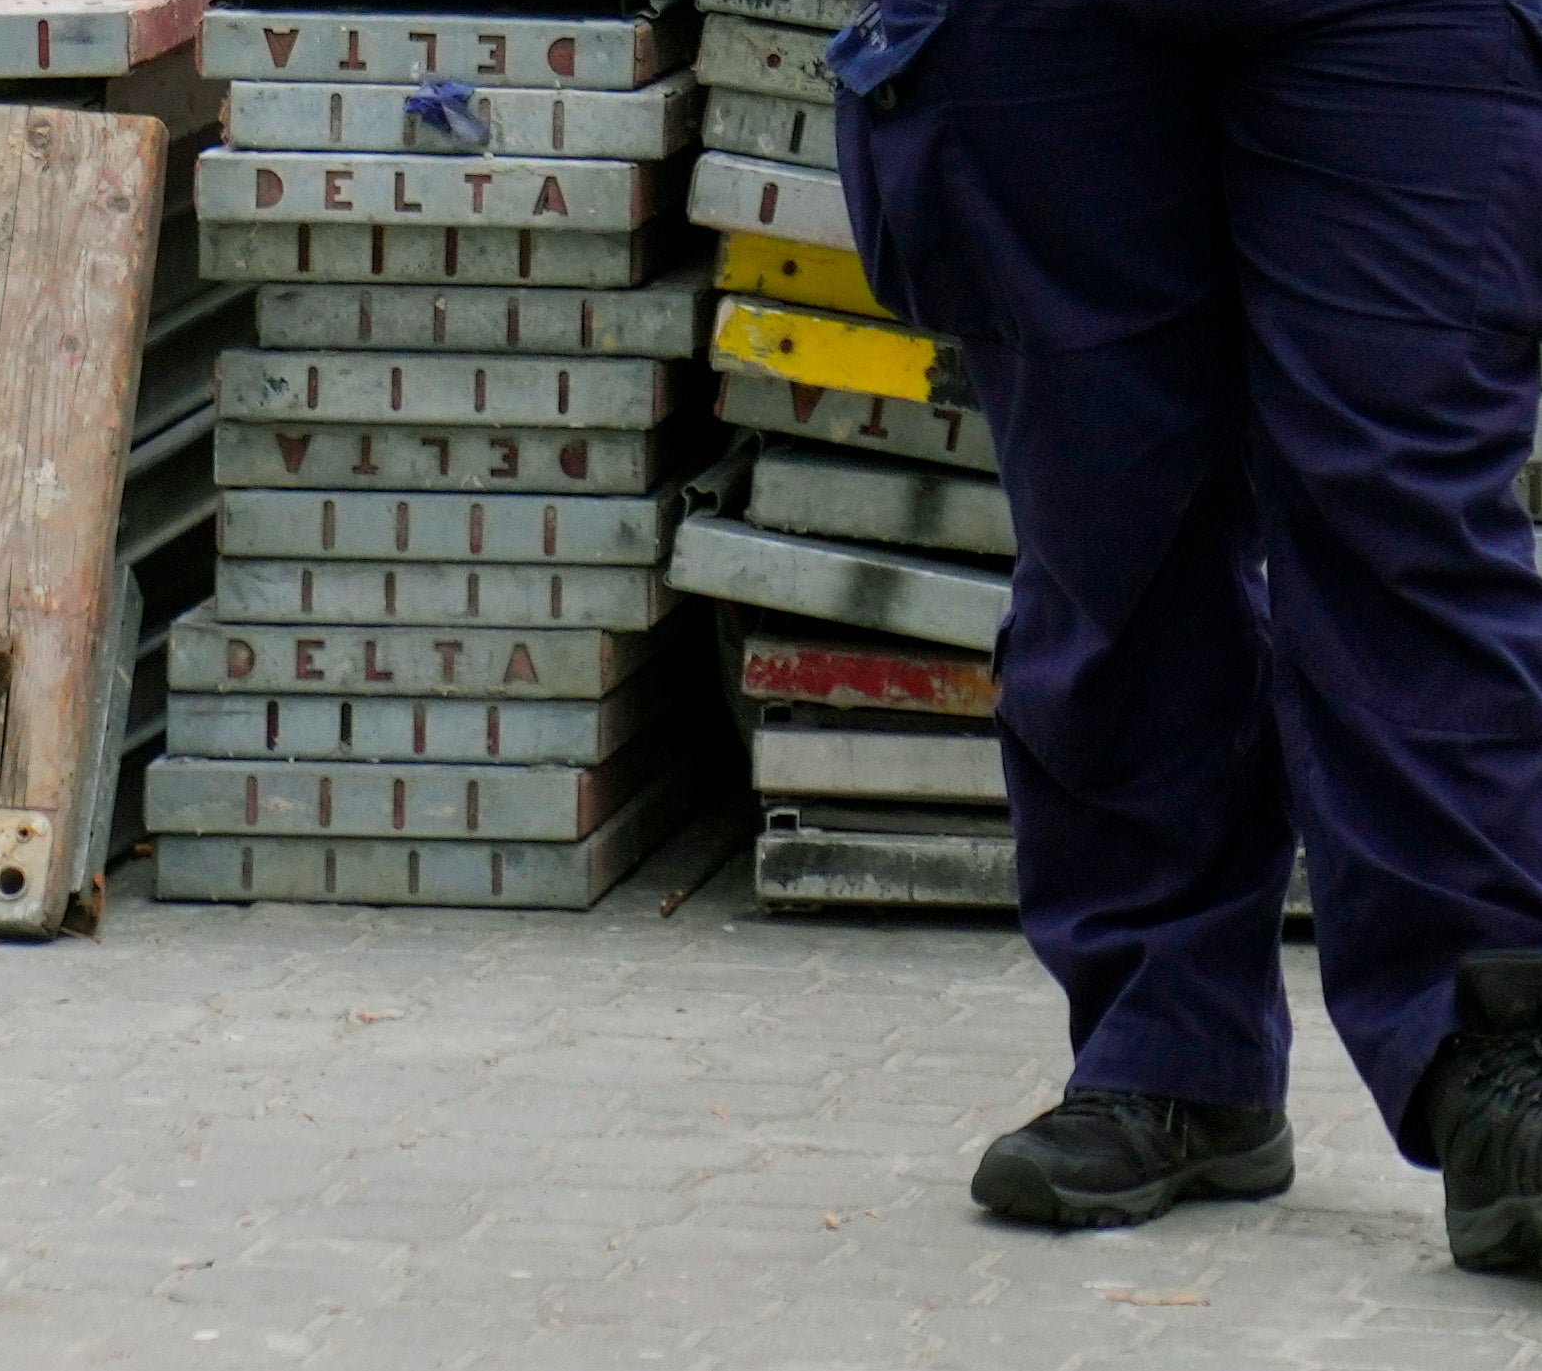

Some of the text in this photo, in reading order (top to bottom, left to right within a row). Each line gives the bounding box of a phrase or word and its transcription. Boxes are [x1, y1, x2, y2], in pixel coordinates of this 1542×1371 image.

[263, 27, 575, 78] DELTA
[255, 168, 569, 216] DELTA
[276, 432, 589, 480] DELTA
[228, 638, 539, 684] DELTA
